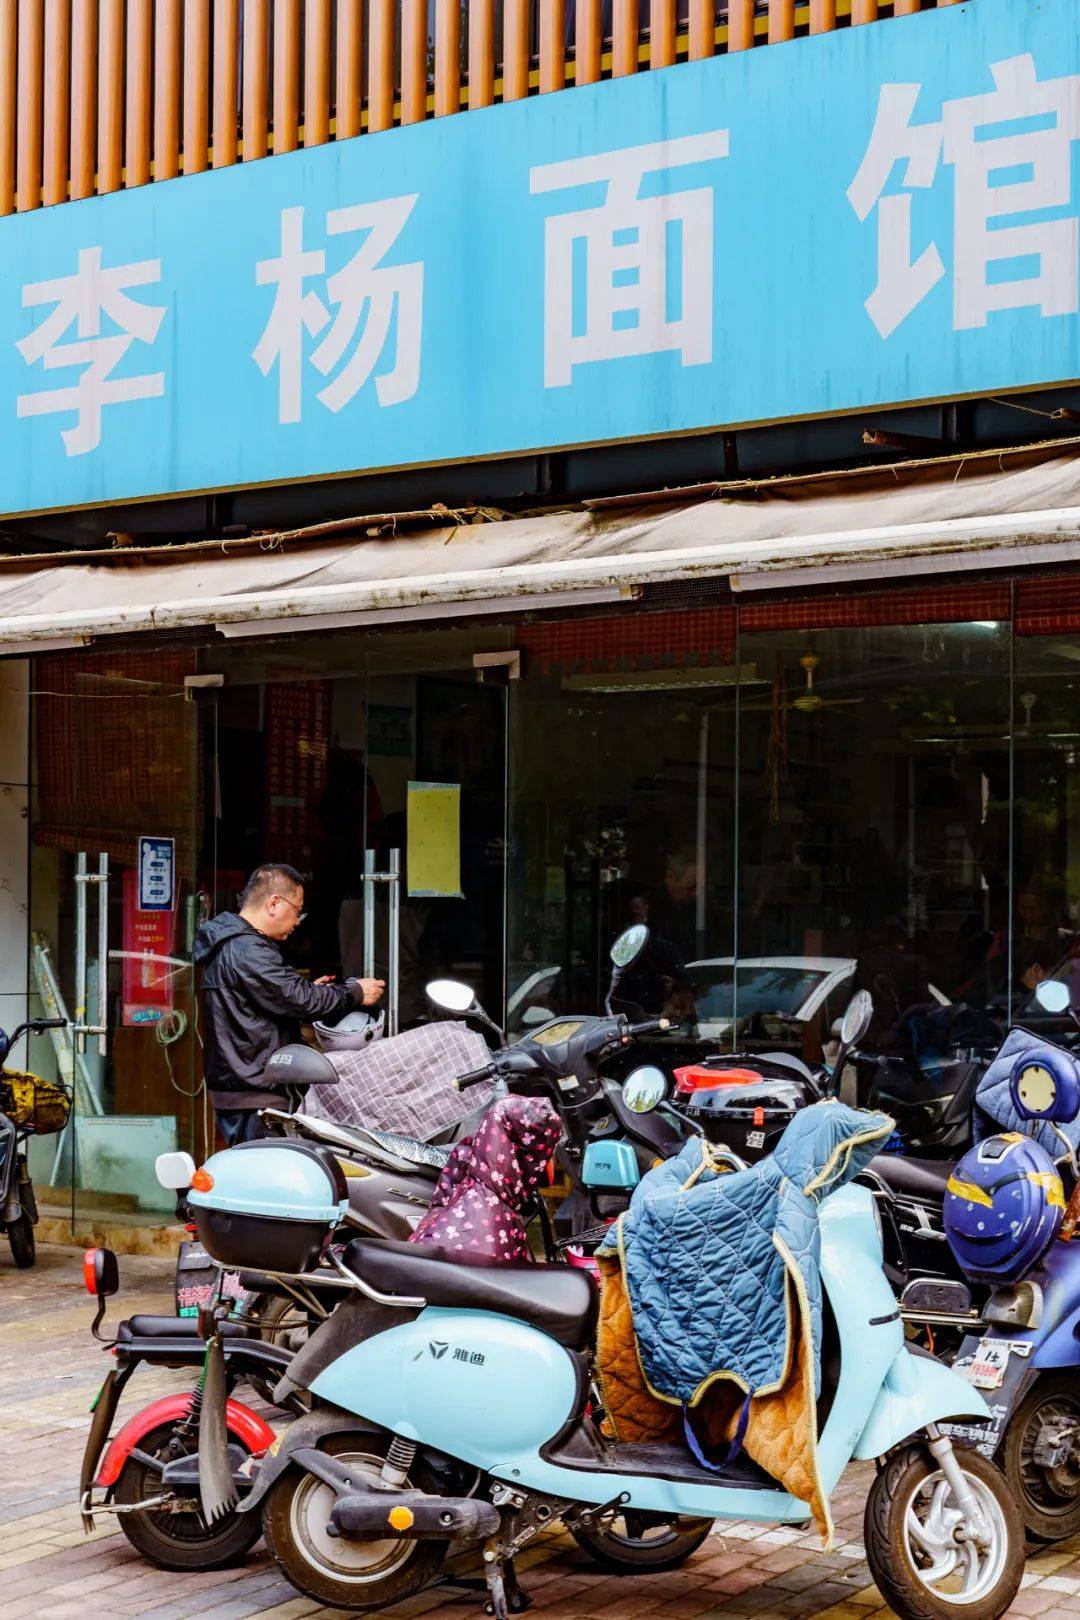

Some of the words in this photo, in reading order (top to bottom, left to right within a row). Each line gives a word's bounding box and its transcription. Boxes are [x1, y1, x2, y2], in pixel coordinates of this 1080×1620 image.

[14, 52, 1080, 457] 李杨面馆
[453, 1348, 485, 1366] 雅迪
